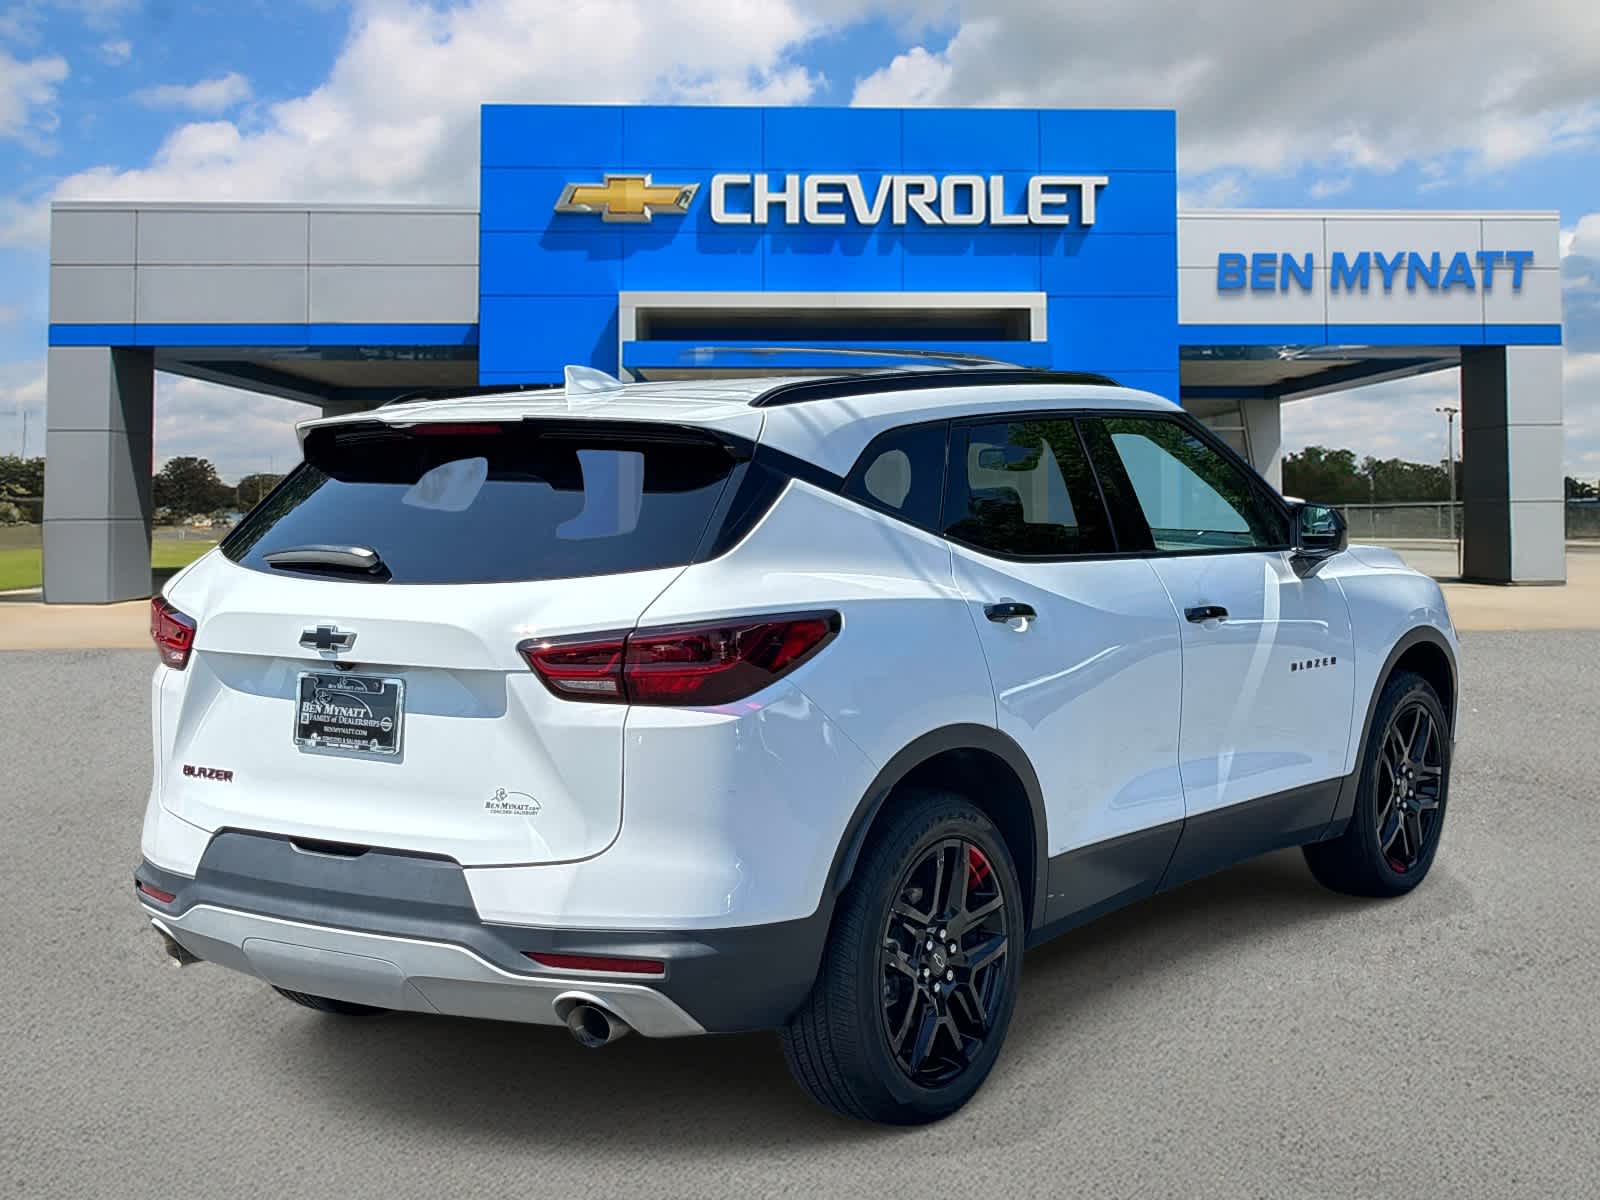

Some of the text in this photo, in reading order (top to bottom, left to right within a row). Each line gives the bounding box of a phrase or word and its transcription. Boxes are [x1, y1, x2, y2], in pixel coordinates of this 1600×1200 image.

[710, 173, 1109, 226] CHEVROLET
[1217, 250, 1534, 291] BEN MYNATT
[1291, 656, 1337, 672] BLAZER
[302, 702, 366, 717] BEN MYNATT
[183, 764, 233, 783] BLAZER
